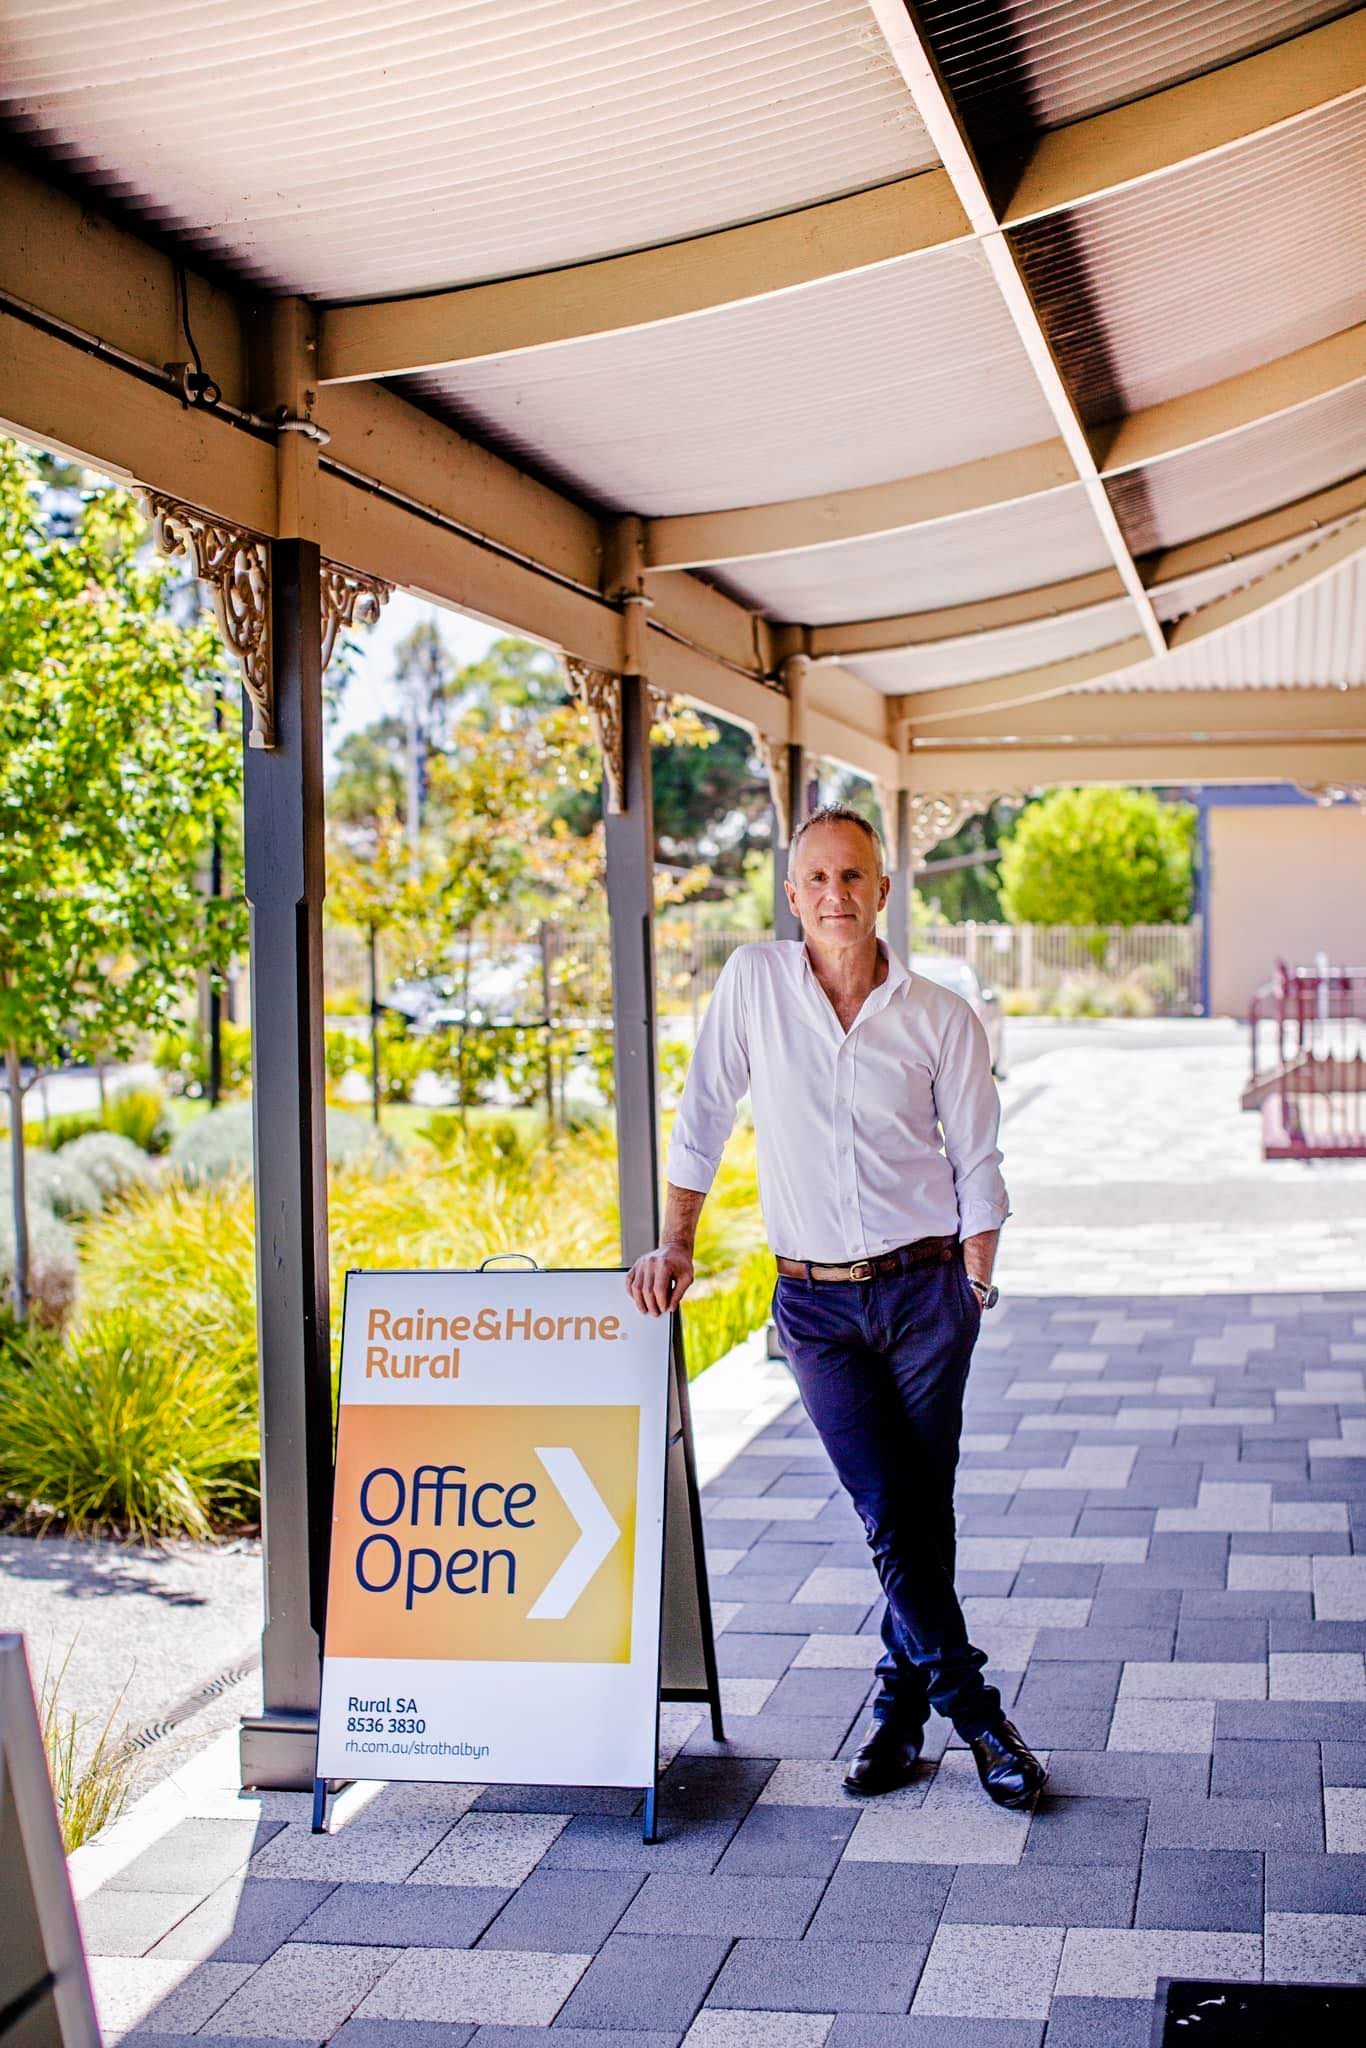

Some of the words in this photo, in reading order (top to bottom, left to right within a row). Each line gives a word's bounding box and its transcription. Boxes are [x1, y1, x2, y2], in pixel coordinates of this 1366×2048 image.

[365, 1346, 460, 1379] Rural
[358, 1465, 537, 1528] Office
[355, 1533, 517, 1610] Open
[348, 1696, 392, 1713] Rural
[395, 1698, 418, 1714] SA
[346, 1717, 384, 1733] 8536
[388, 1718, 426, 1734] 3830
[345, 1739, 490, 1760] rh.com.au/strathalbyn
